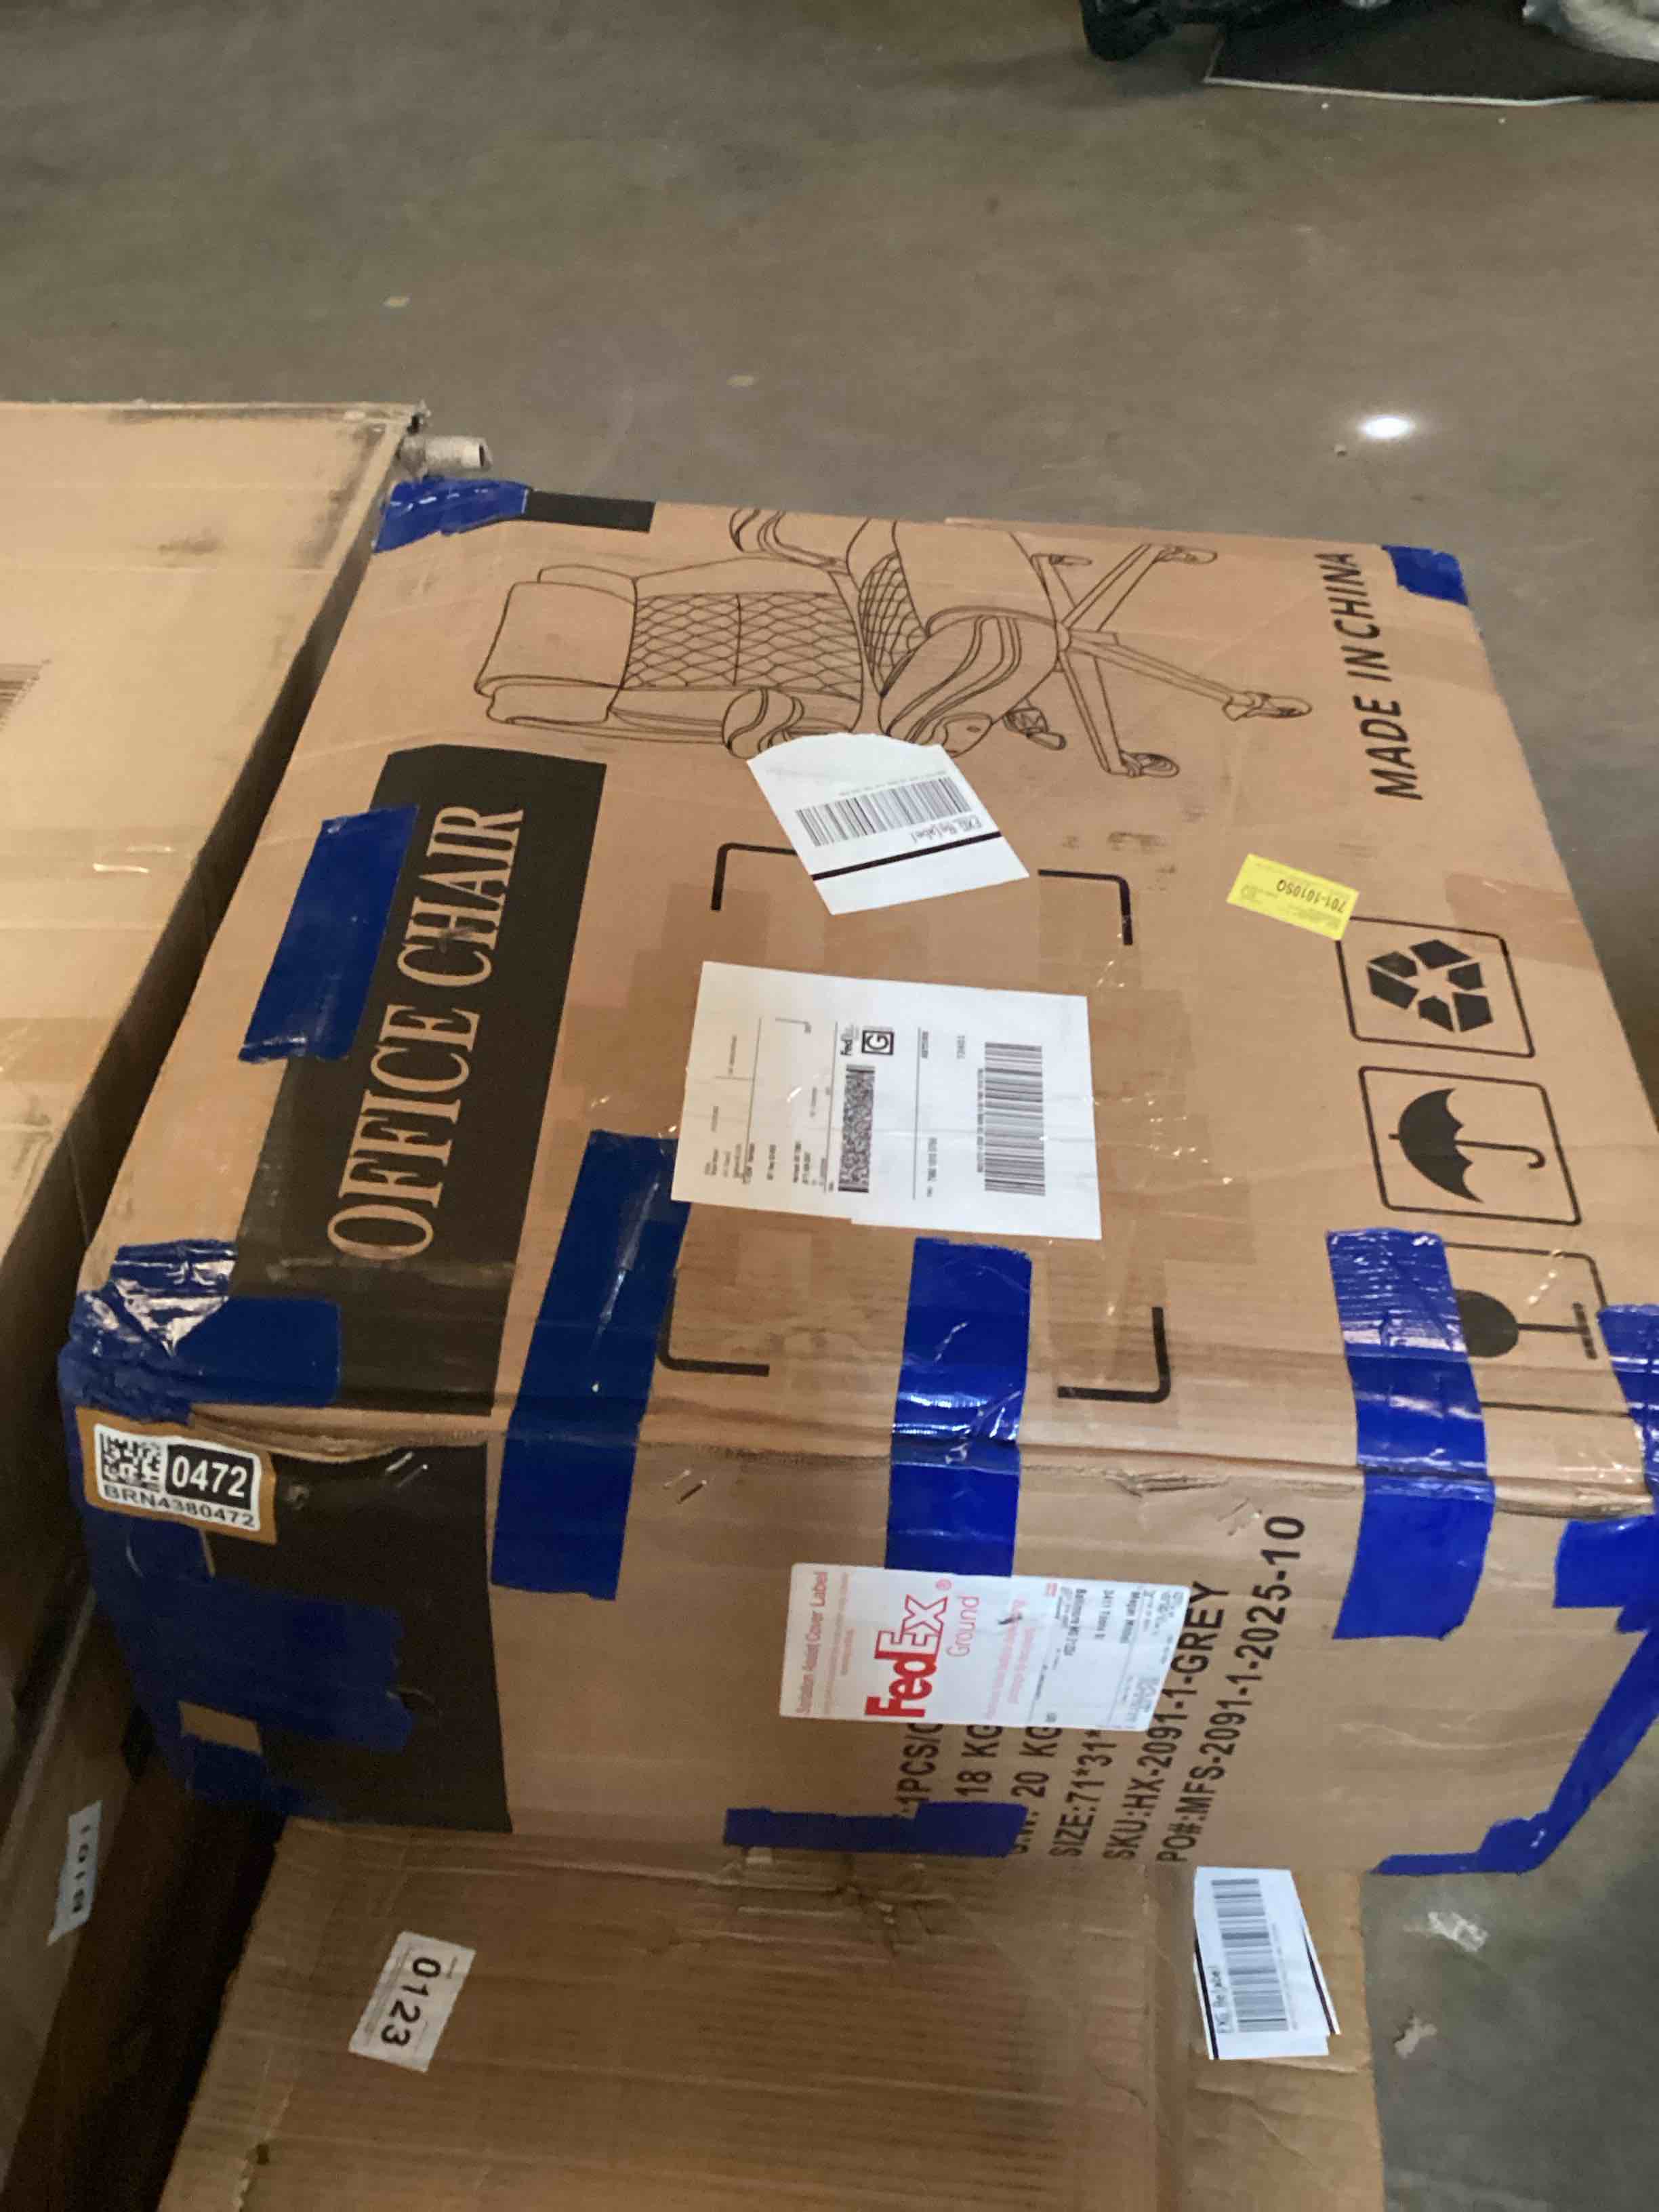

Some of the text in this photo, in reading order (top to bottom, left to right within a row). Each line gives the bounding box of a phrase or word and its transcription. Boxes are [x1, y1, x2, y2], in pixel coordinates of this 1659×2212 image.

[1314, 553, 1422, 800] MADE IN CHINA
[327, 806, 524, 1260] OFFICE CHAIR
[865, 1034, 889, 1050] G
[103, 1483, 255, 1528] BRN4380472
[171, 1455, 247, 1498] 0472
[809, 1571, 827, 1607] Label
[865, 1594, 948, 1718] FedEx
[946, 1595, 980, 1658] Ground
[1156, 1515, 1306, 1863] PO#:MFS-2091-1-2025-10
[1101, 1581, 1229, 1862] SKU:HX-2091-1-GREY
[954, 1770, 992, 1797] 18
[1010, 1771, 1050, 1798] 20
[381, 1957, 442, 2047] 0123
